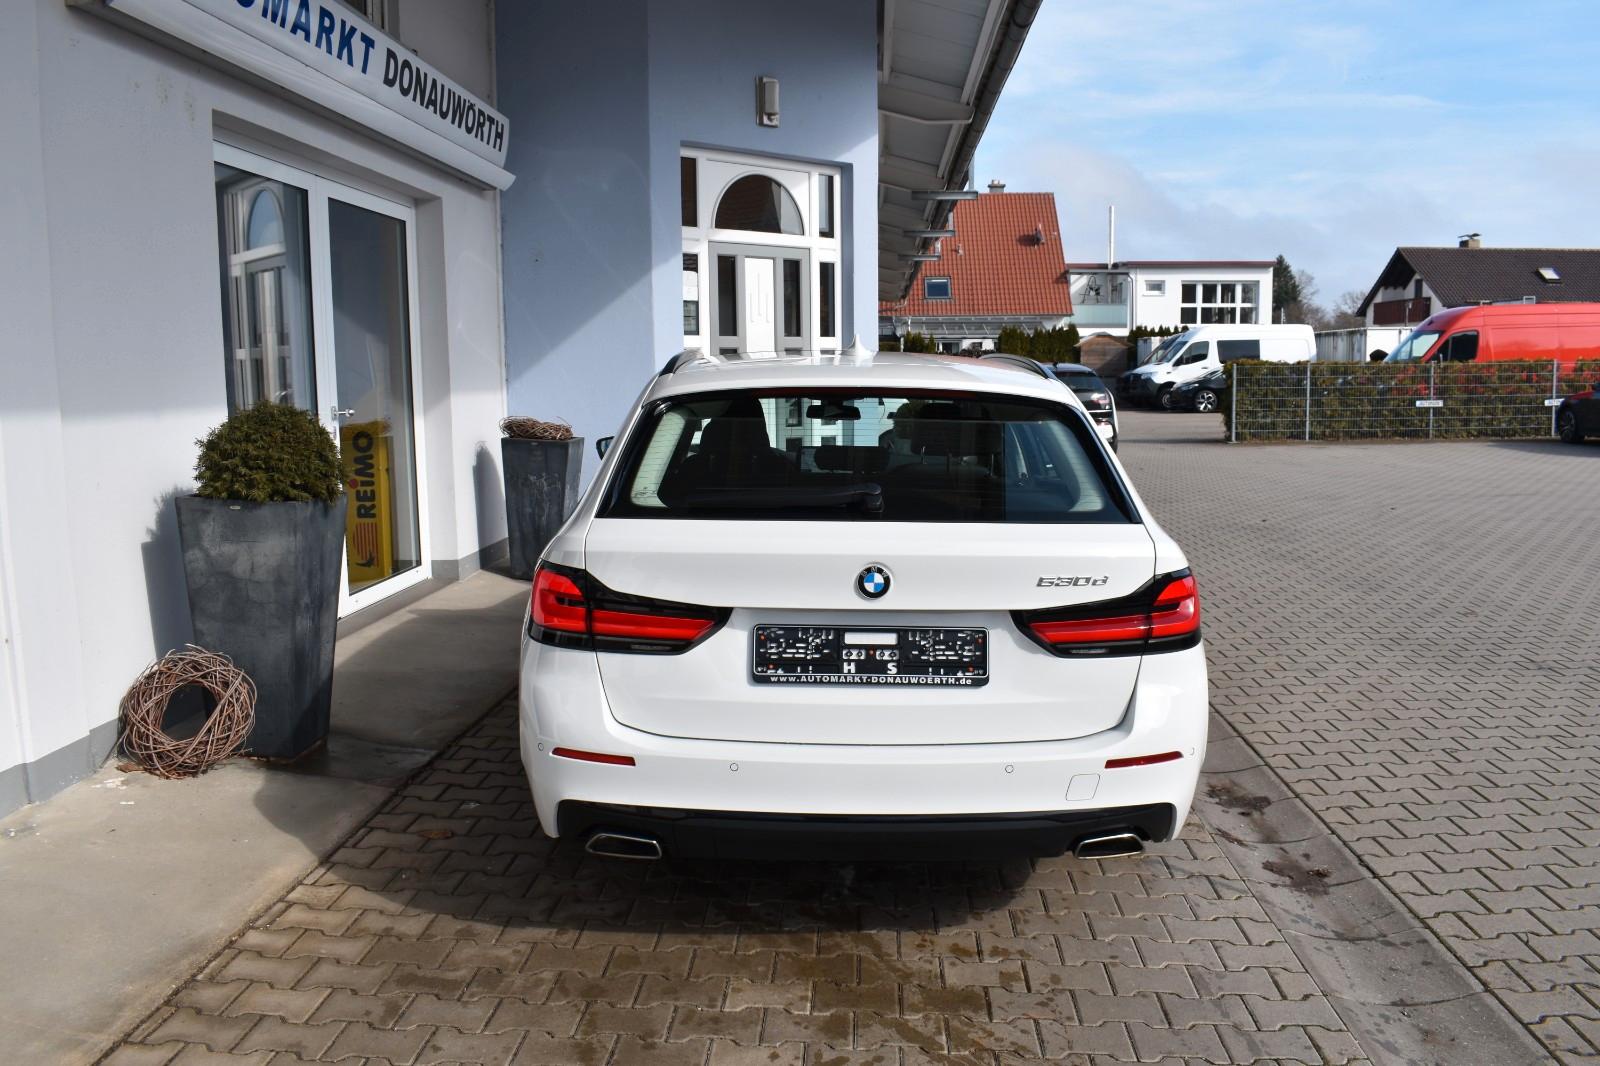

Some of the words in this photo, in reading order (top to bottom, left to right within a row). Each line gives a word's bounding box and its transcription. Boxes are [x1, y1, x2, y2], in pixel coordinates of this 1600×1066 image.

[235, 0, 375, 75] MARKT
[383, 47, 505, 152] DONAUWÖRTH
[843, 661, 856, 674] H
[886, 662, 898, 675] S
[770, 675, 972, 685] www.AUTOMARKT-DONAUWOERTH.de
